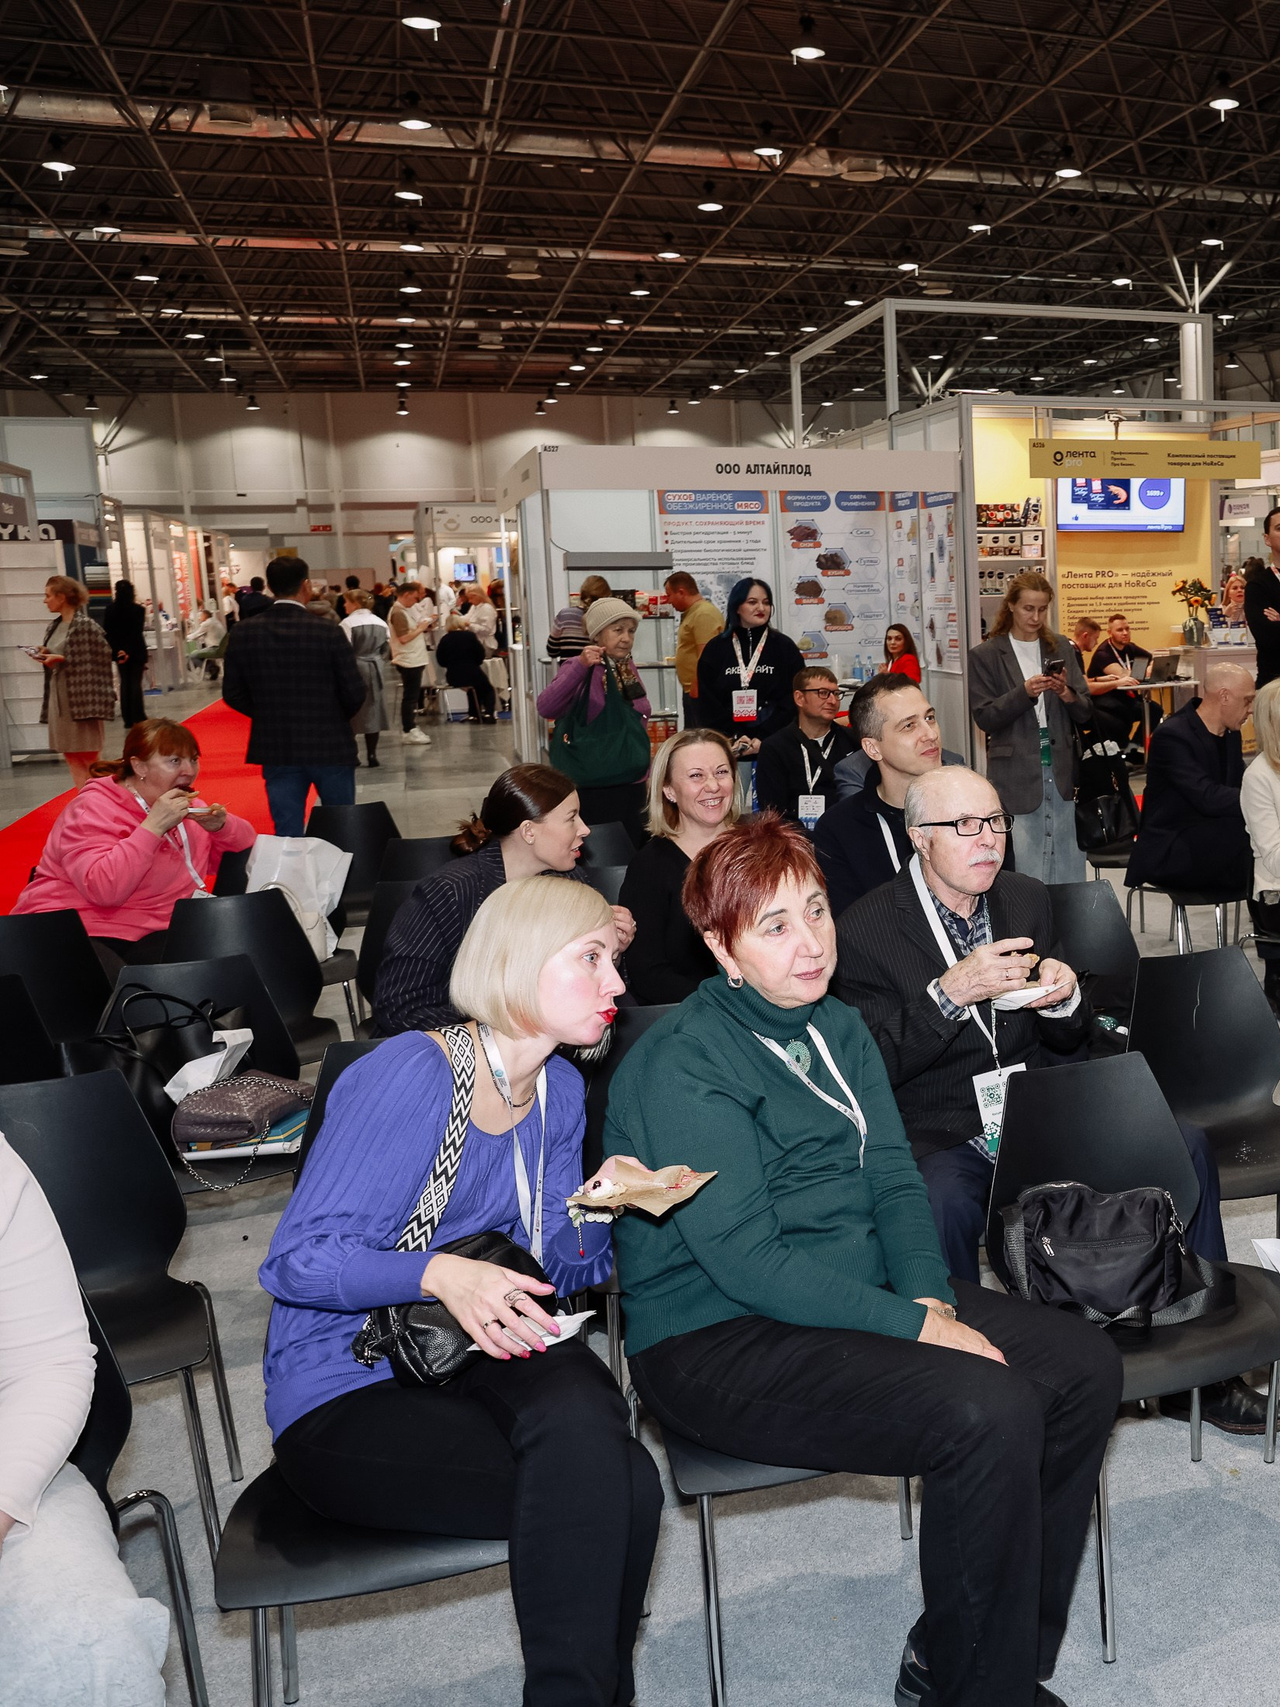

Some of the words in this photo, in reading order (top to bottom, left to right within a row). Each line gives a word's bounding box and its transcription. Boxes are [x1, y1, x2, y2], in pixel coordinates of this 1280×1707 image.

[1065, 450, 1097, 459] лента
[1065, 459, 1083, 468] pro
[716, 463, 741, 474] ООО
[746, 462, 812, 476] АЛТАЙПЛОД
[666, 493, 694, 501] СУХОЕ
[696, 492, 733, 501] ВАРЁНОЕ
[667, 502, 734, 510] ОБЕЗЖИРЕННОЕ
[736, 502, 761, 510] МЯСО
[1062, 571, 1093, 579] «Лента
[1095, 570, 1119, 578] PRO»
[1131, 570, 1173, 579] надёжный
[1062, 581, 1106, 589] поставщик
[1108, 581, 1122, 589] для
[1124, 580, 1157, 588] HoReCa
